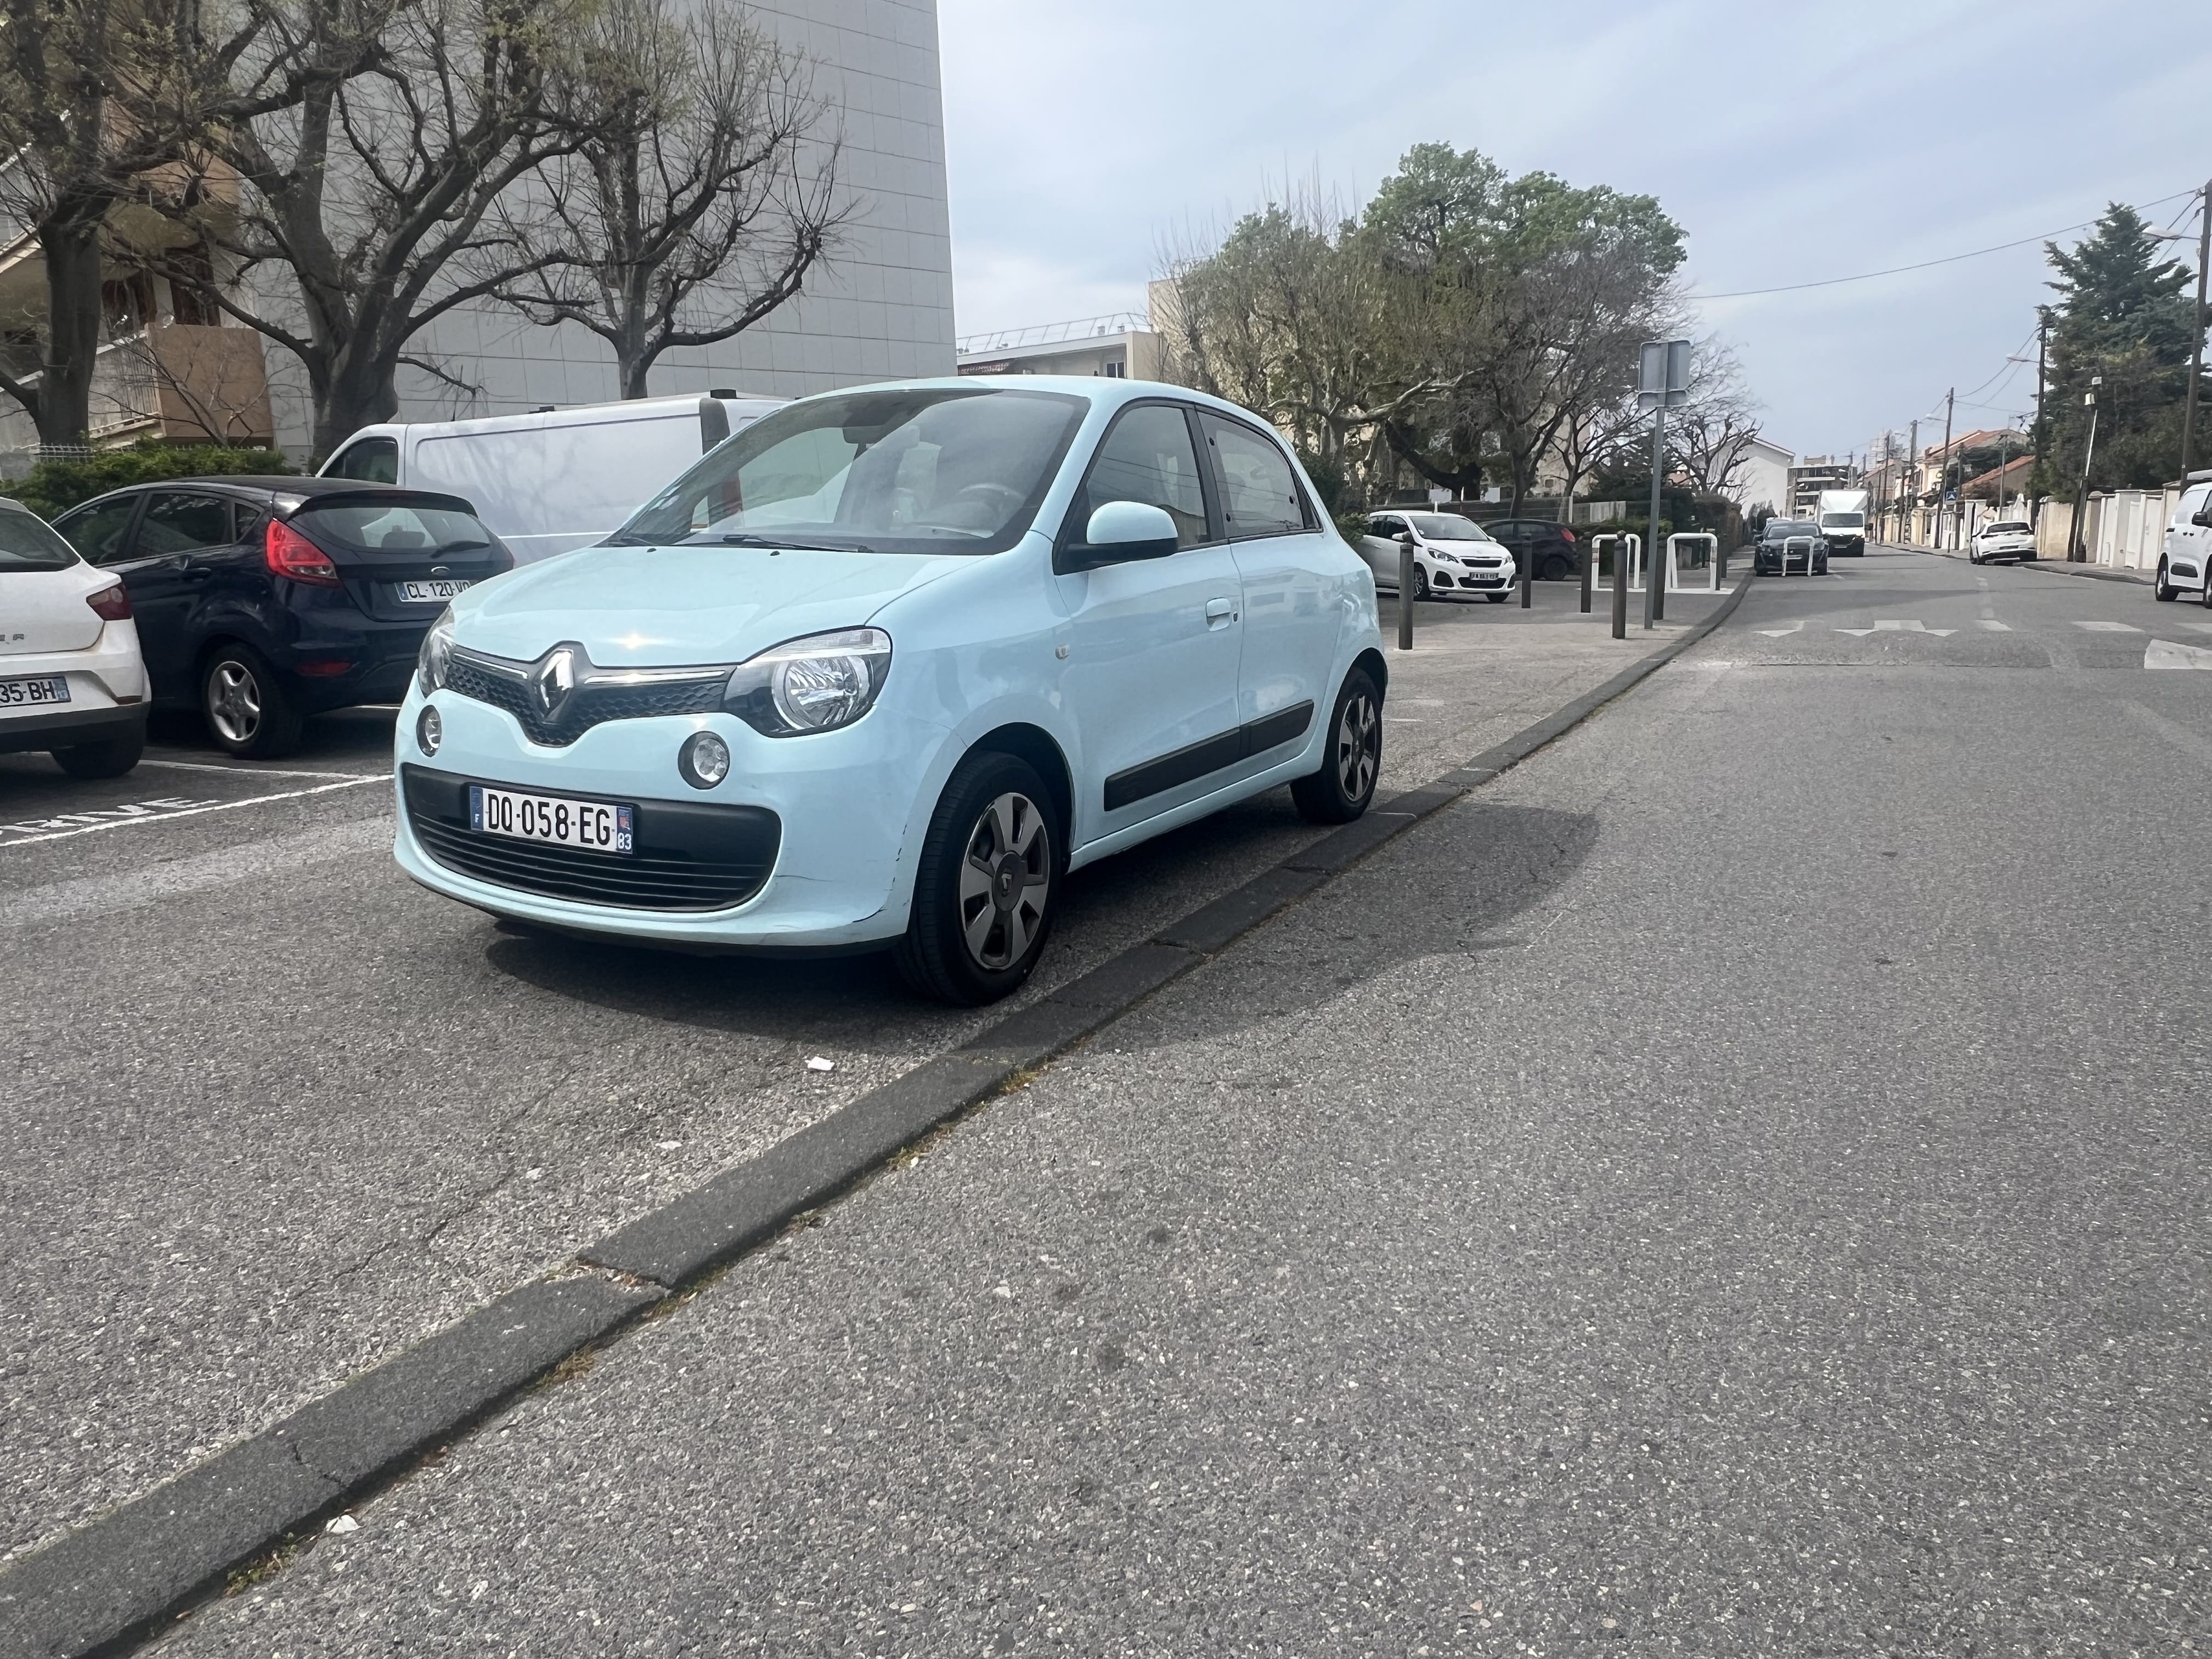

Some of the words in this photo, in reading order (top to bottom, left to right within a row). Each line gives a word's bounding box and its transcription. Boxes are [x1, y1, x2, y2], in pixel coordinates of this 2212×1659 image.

[0, 797, 222, 835] RIVE
[488, 793, 610, 845] DQ-058-EG
[617, 832, 631, 850] 83
